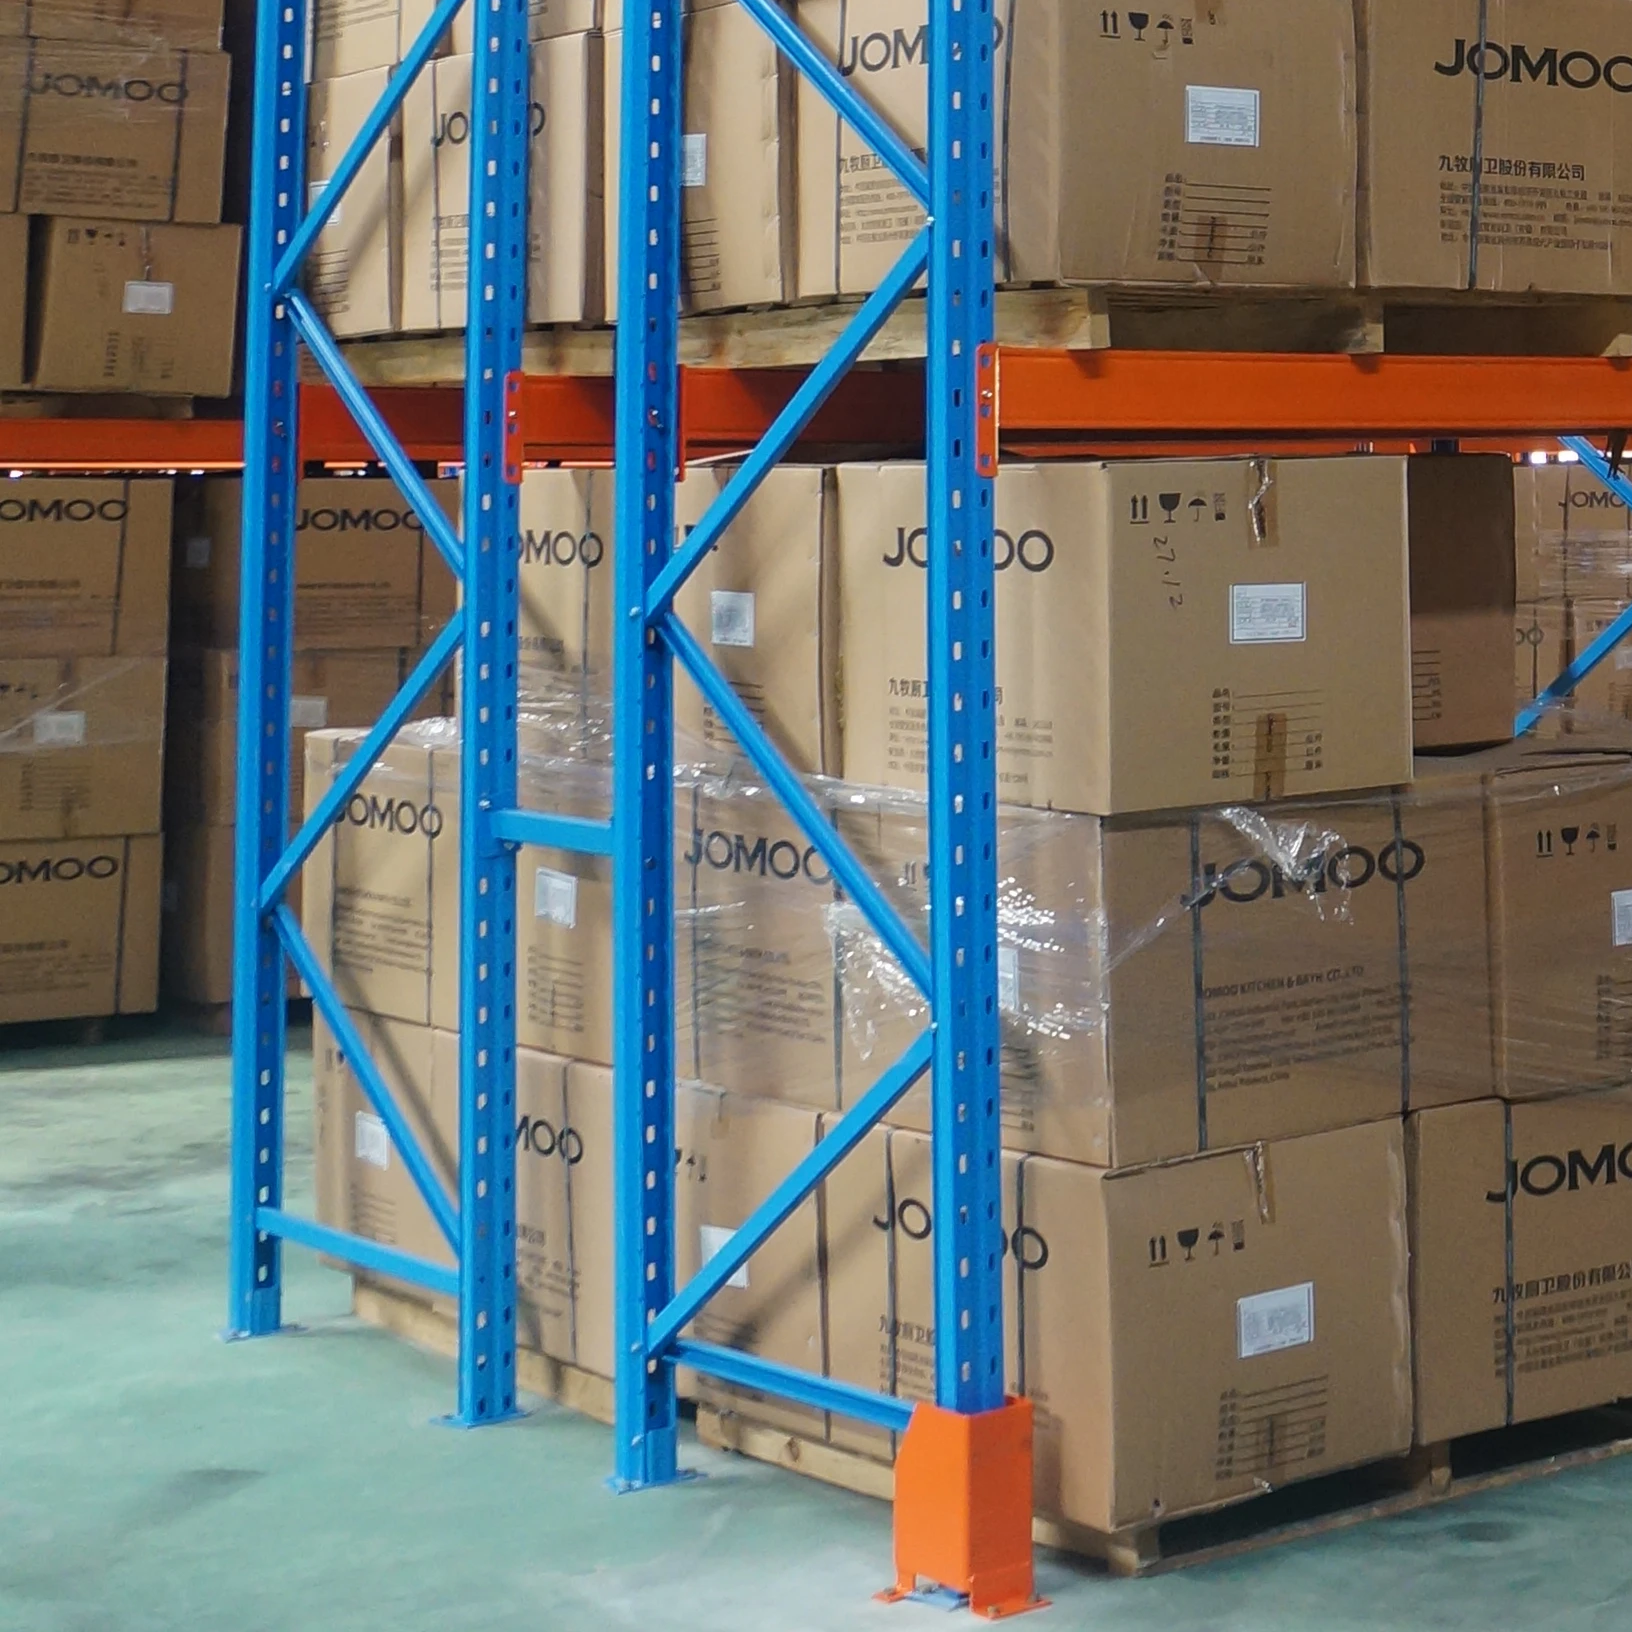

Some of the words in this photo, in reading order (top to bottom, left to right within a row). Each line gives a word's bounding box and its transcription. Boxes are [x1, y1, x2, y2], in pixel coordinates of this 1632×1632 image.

[26, 77, 189, 104] JOMOO
[0, 498, 128, 522] OMOO
[1558, 490, 1627, 510] JOMO
[520, 530, 603, 567] MOO
[335, 794, 442, 839] OMOO
